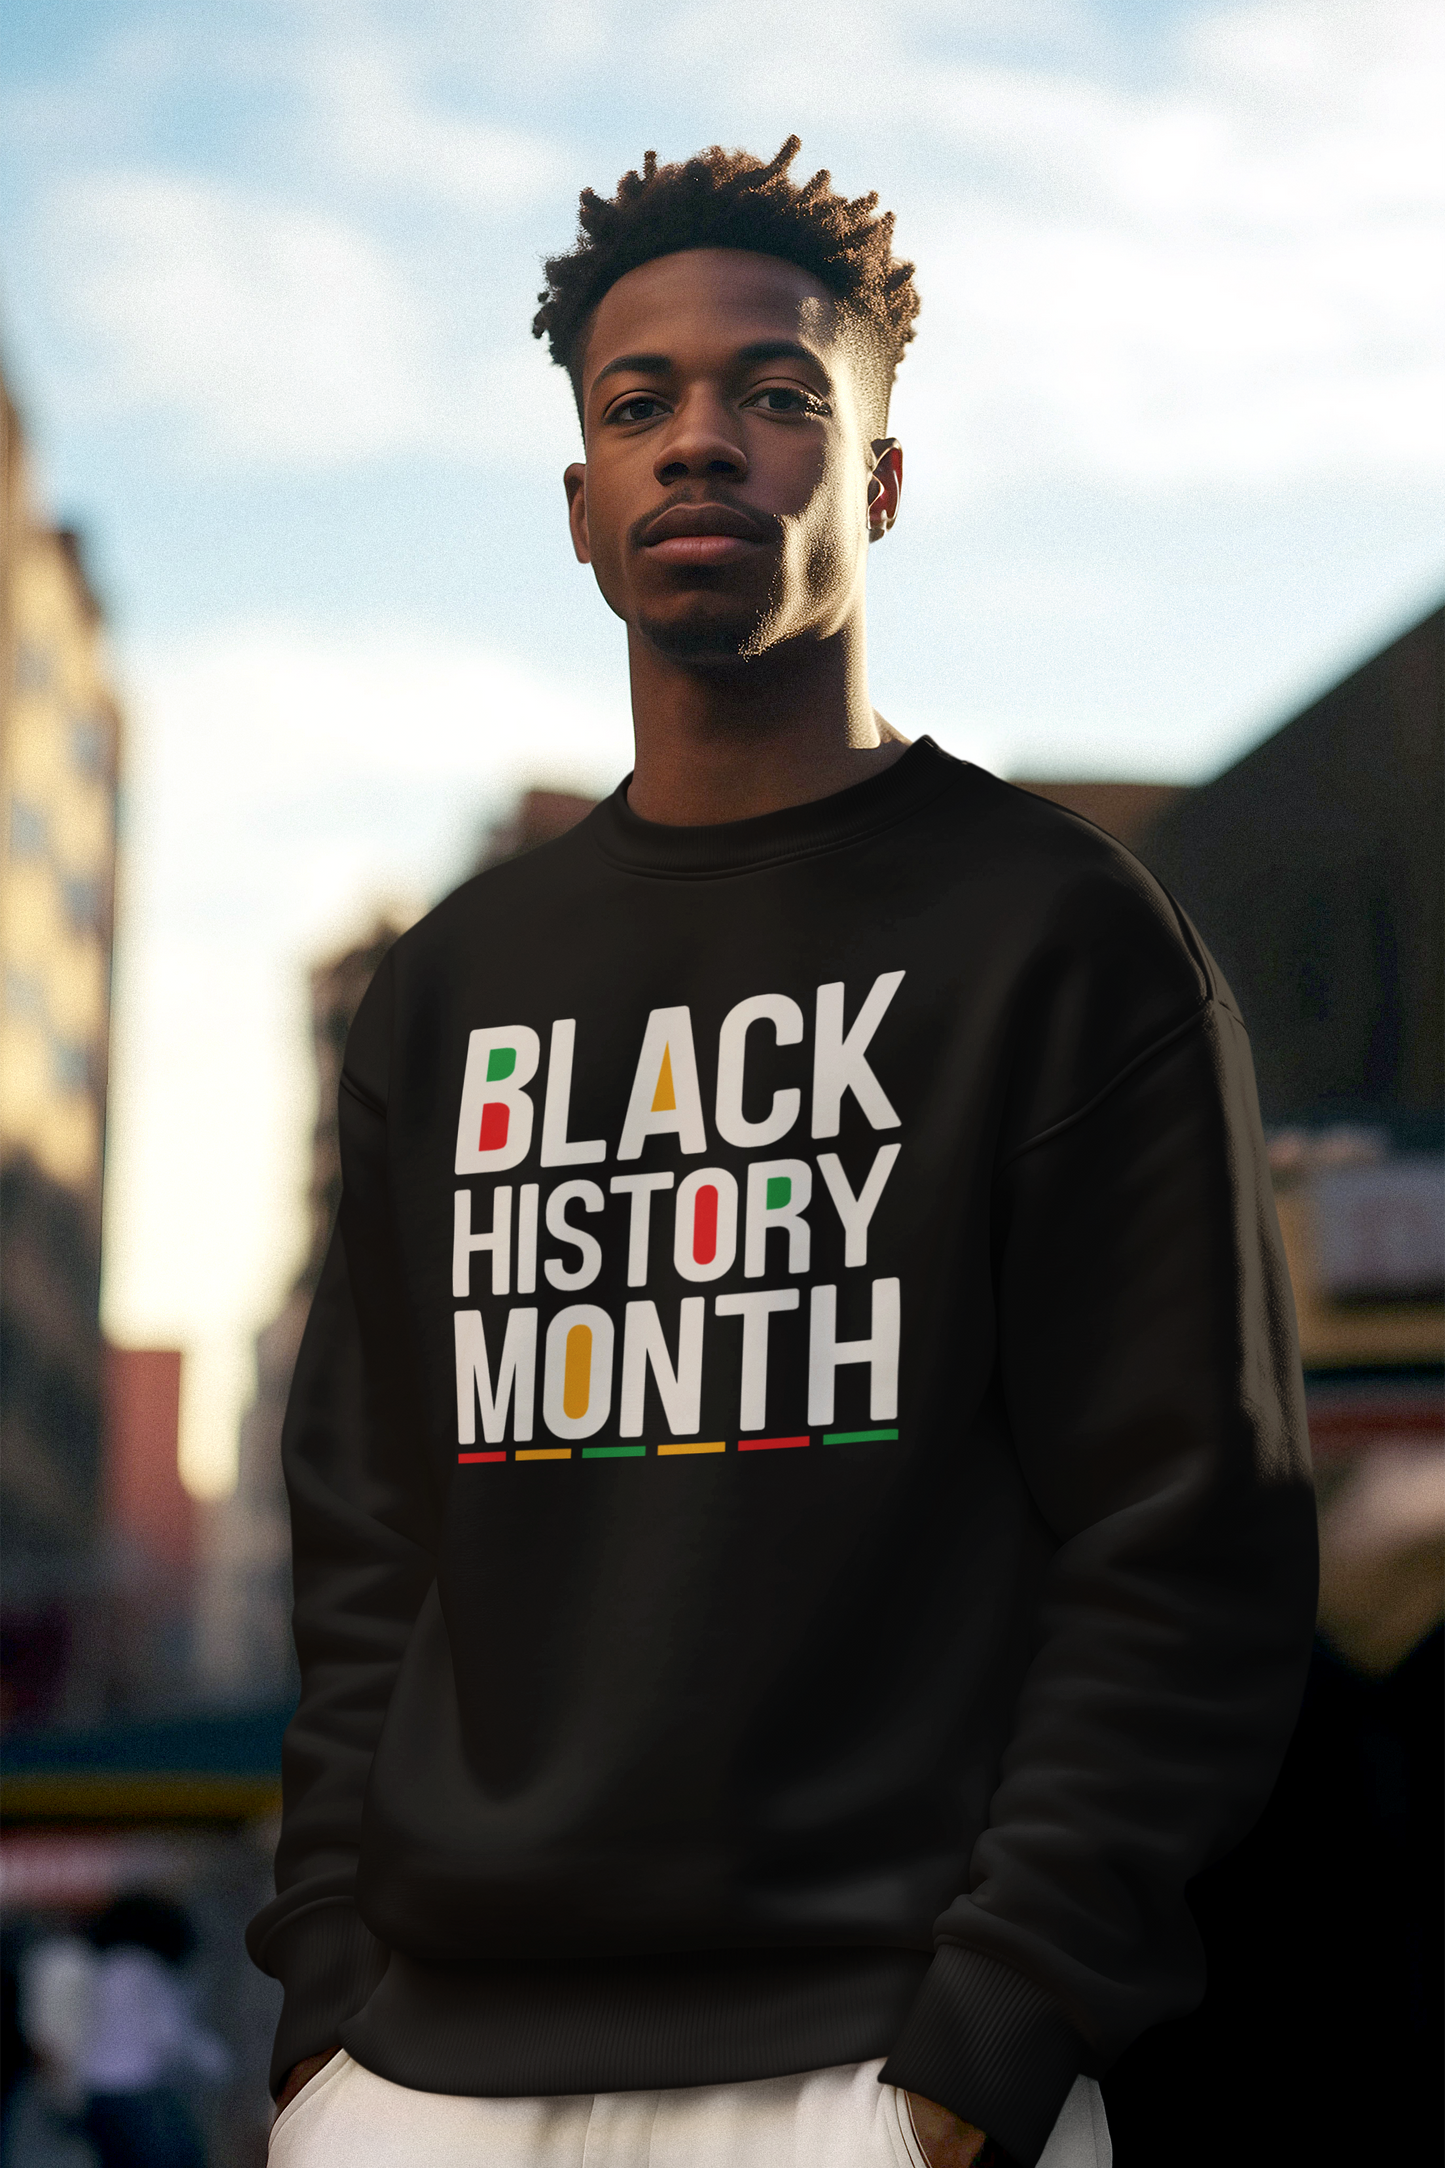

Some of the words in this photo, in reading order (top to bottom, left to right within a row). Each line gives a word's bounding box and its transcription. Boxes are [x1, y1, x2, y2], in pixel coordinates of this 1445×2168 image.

[454, 970, 906, 1175] BLACK
[452, 1143, 902, 1297] HISTORY
[453, 1277, 901, 1444] MONTH
